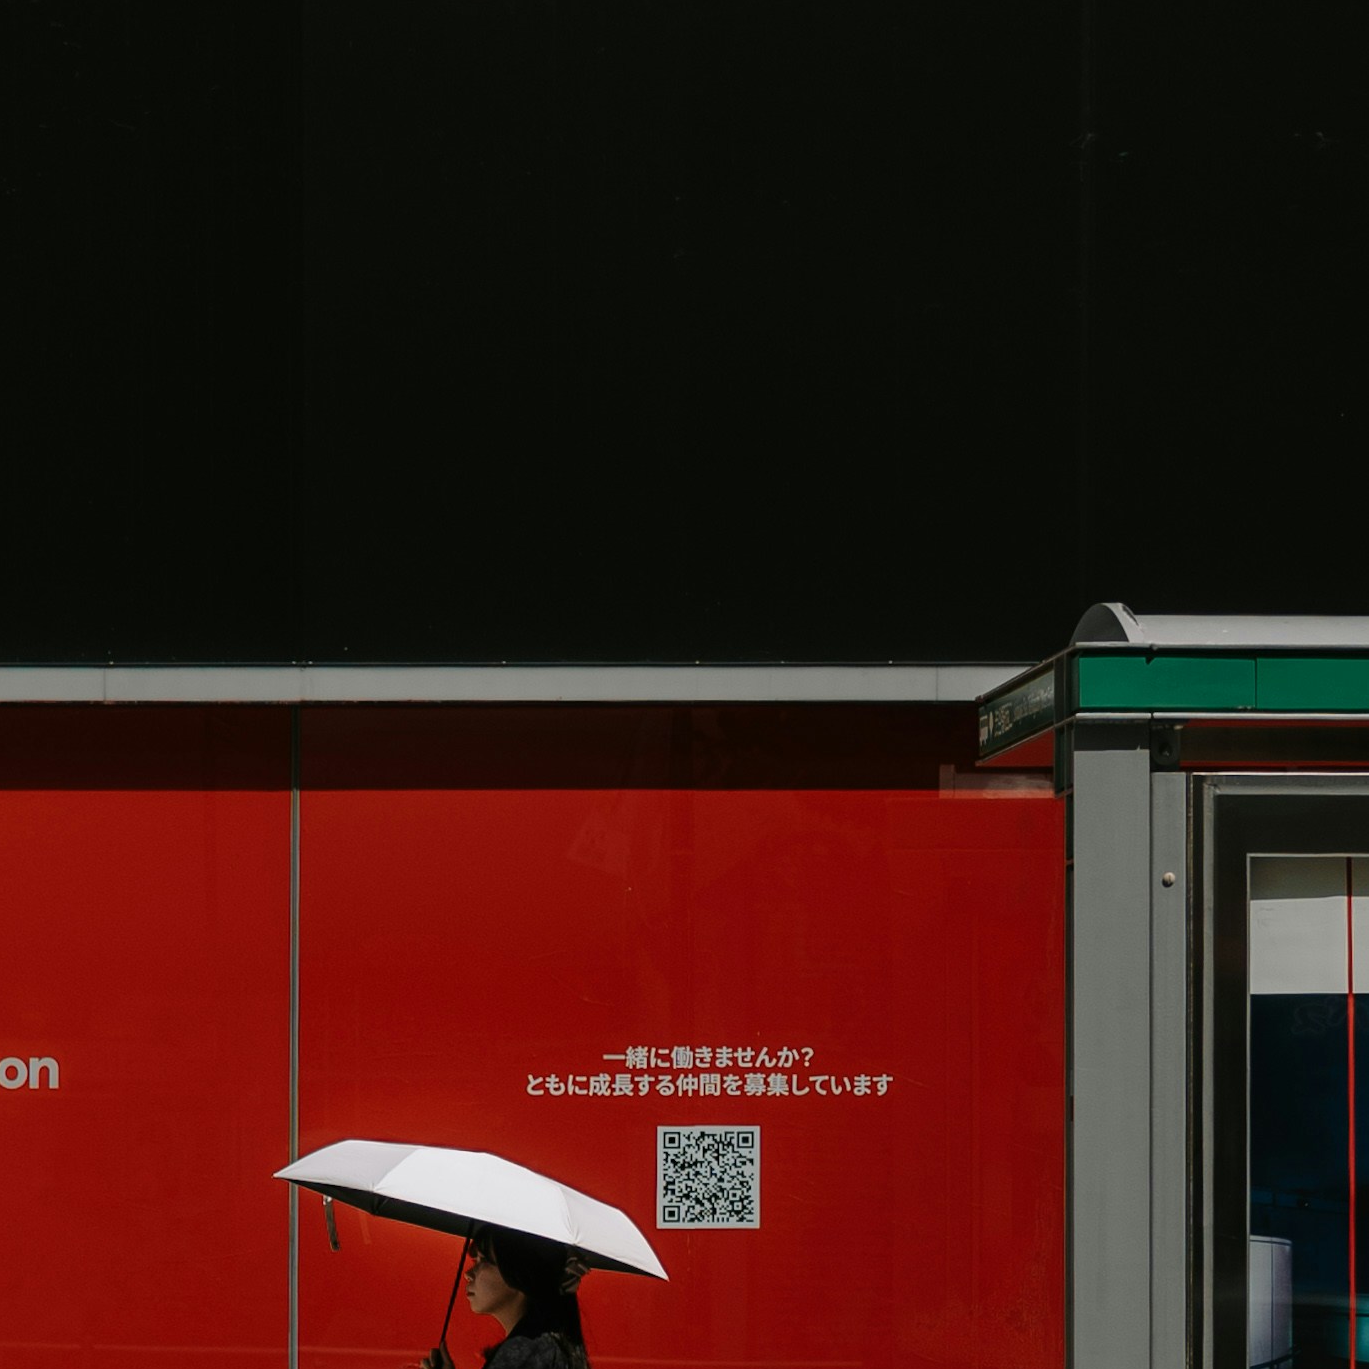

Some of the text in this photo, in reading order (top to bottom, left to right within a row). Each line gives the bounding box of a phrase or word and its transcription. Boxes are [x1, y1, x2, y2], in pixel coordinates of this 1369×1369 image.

[526, 1073, 894, 1098] ともに成長する仲間を募集しています
